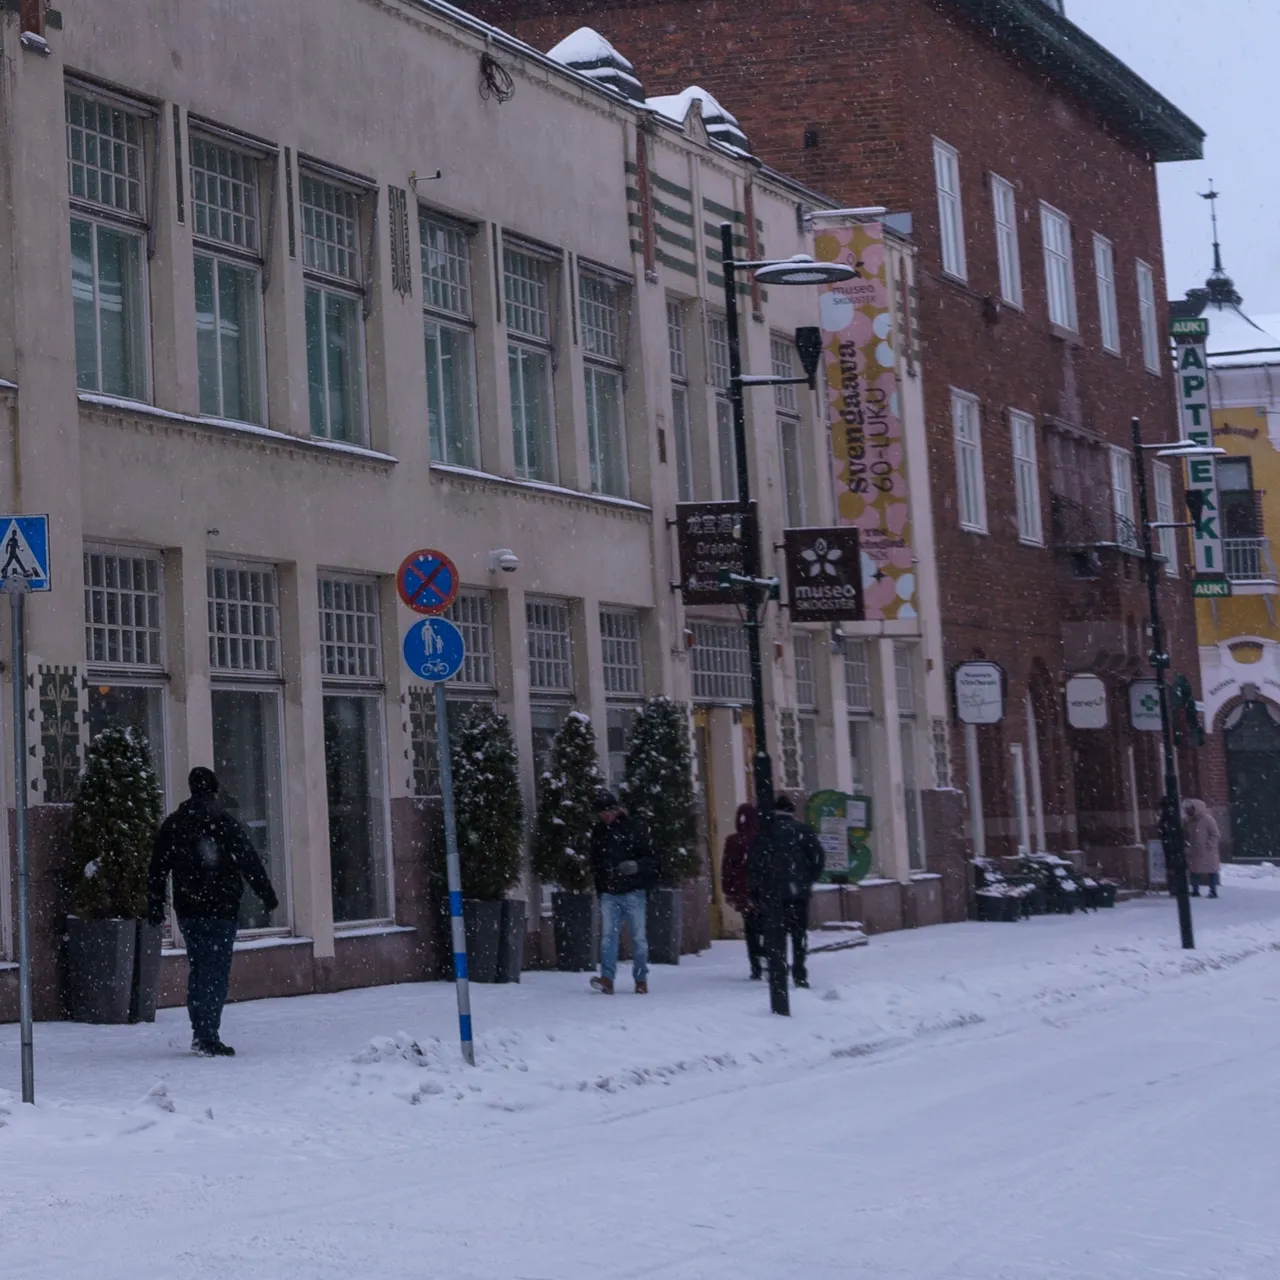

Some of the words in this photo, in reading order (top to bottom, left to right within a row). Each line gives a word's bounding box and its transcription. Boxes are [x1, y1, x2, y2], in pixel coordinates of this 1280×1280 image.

[832, 284, 874, 296] museo
[1171, 320, 1206, 333] AUKI
[839, 340, 869, 494] Svengaava
[865, 387, 894, 493] 60-LUKU
[696, 541, 741, 556] Dragon
[795, 584, 856, 598] museo
[1195, 583, 1229, 595] AUKI
[795, 599, 856, 610] SKOGSTER
